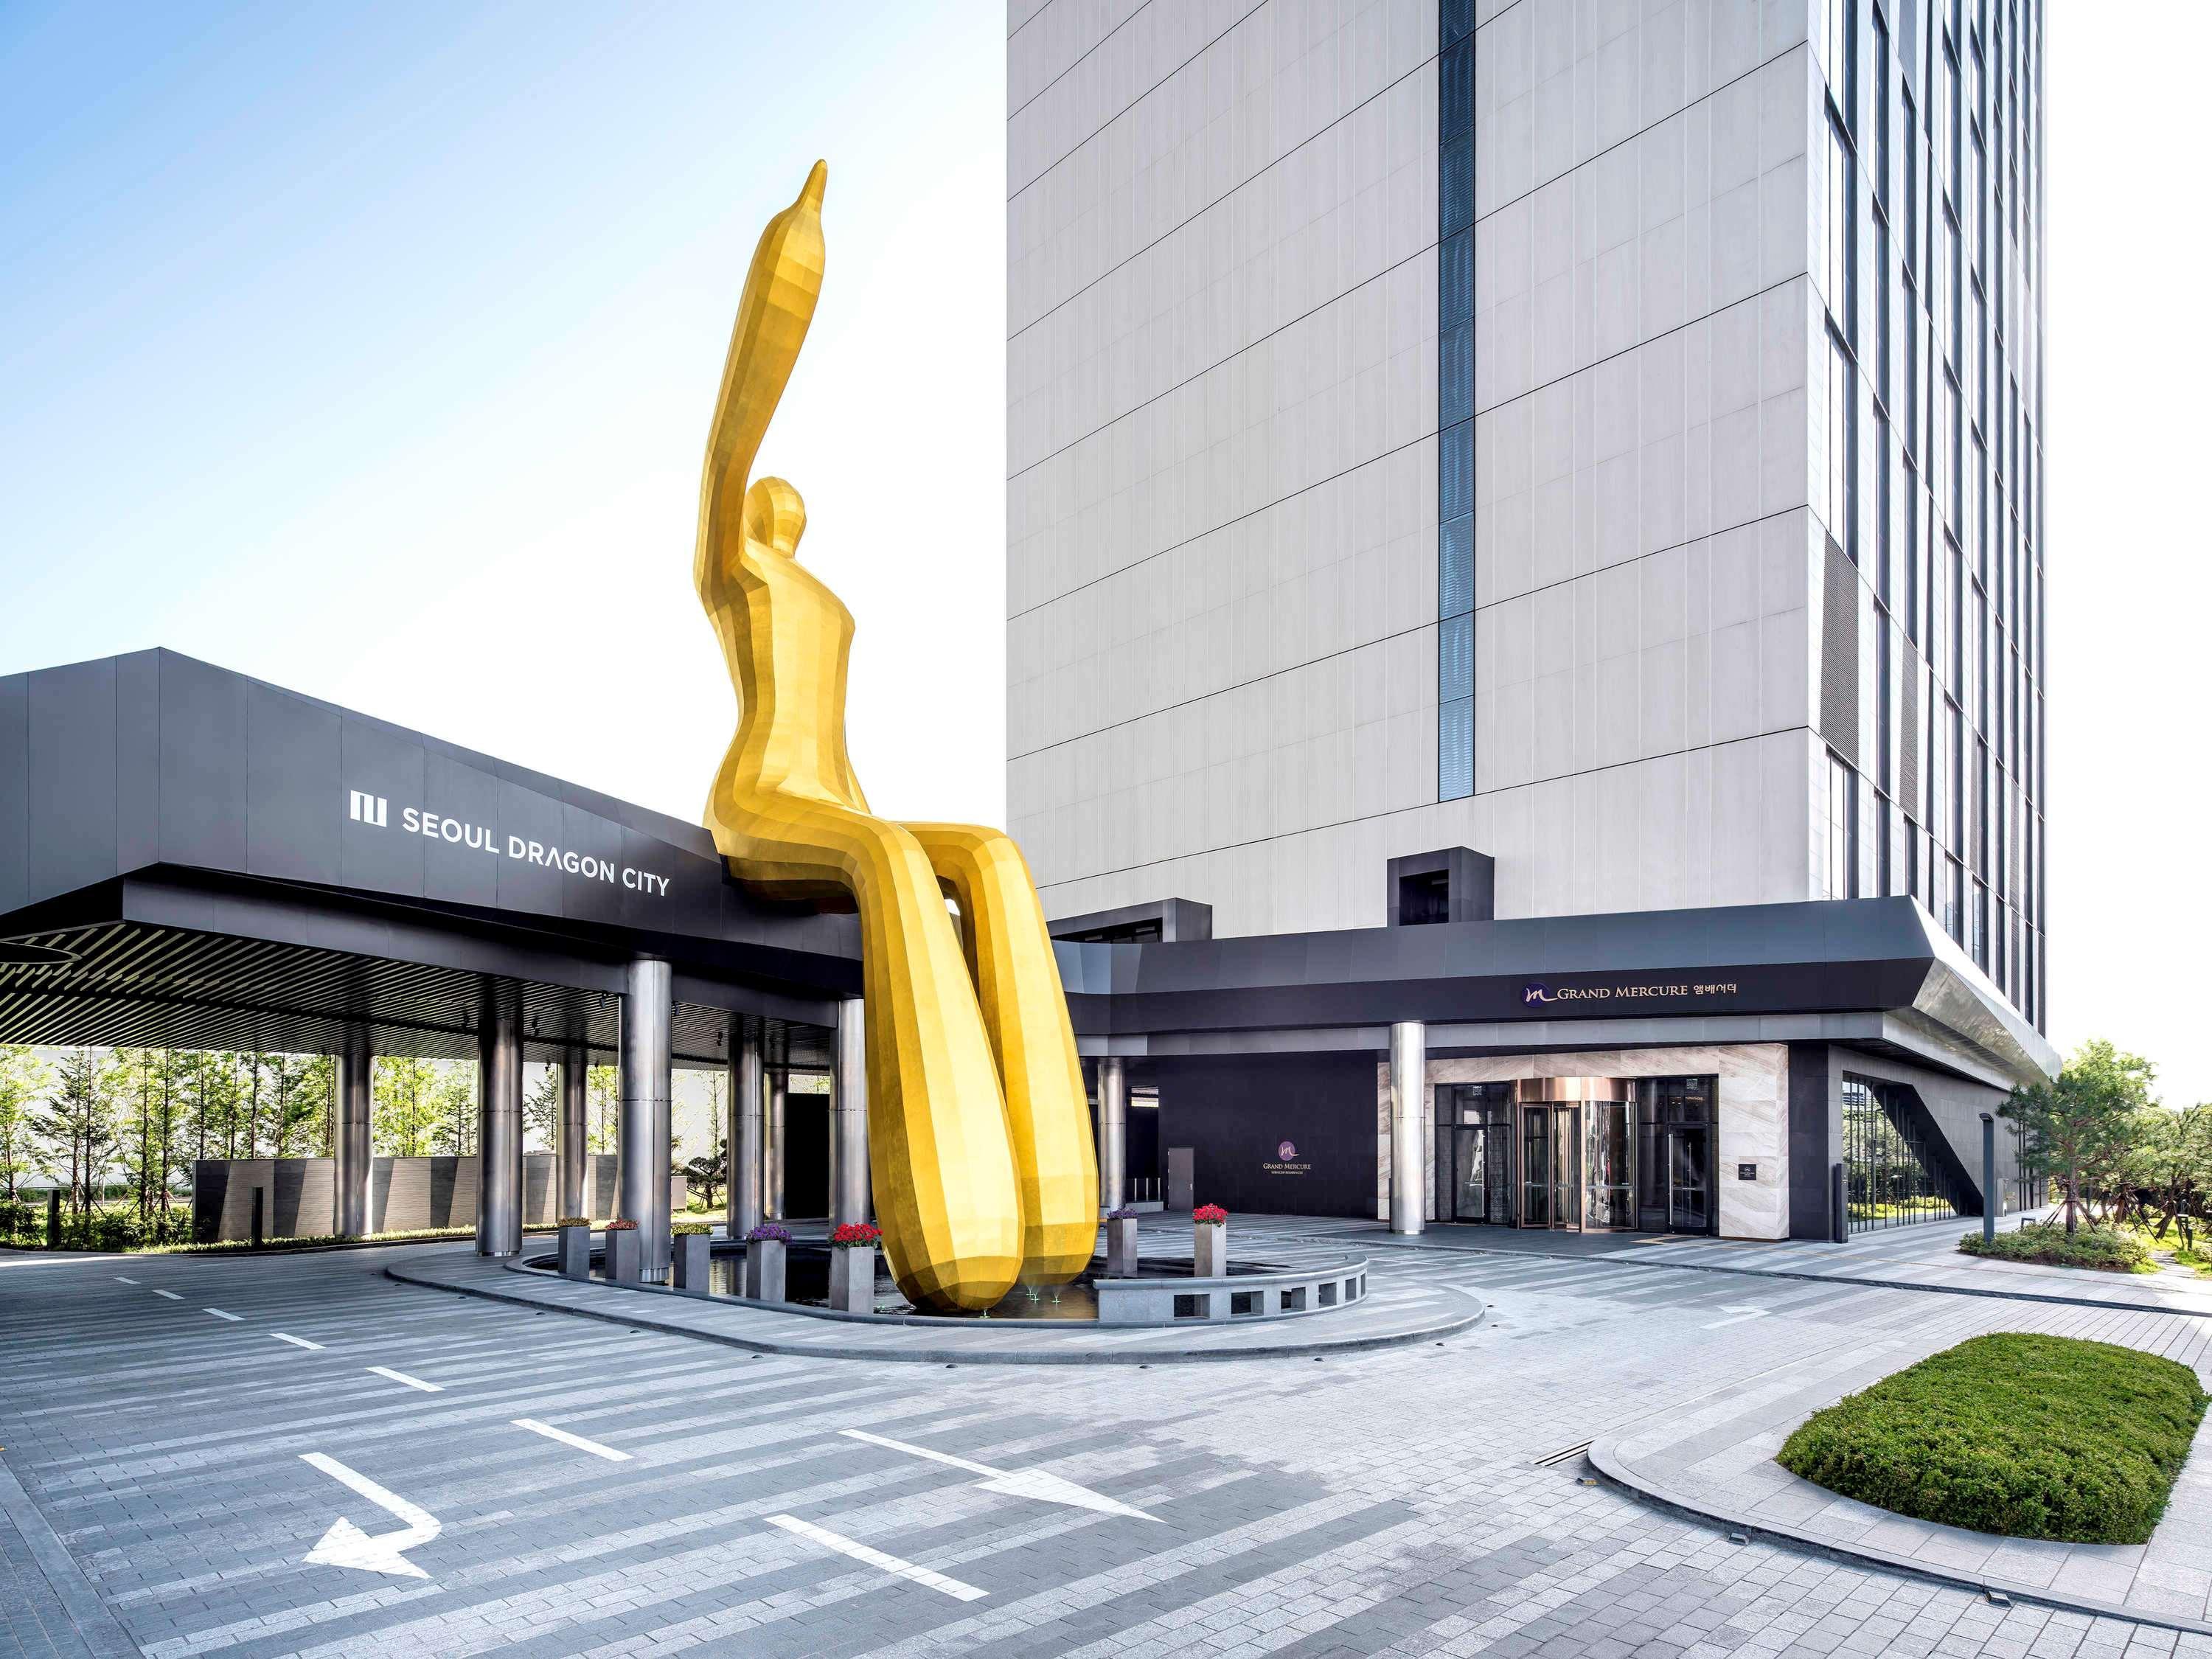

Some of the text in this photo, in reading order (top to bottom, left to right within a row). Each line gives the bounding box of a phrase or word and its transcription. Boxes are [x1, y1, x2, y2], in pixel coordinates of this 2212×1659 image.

[402, 807, 670, 897] SEOUL DRAGON CITY
[1557, 988, 1610, 1000] GRAND
[1615, 985, 1688, 998] MERCURE
[1693, 984, 1736, 995] 앰배서더
